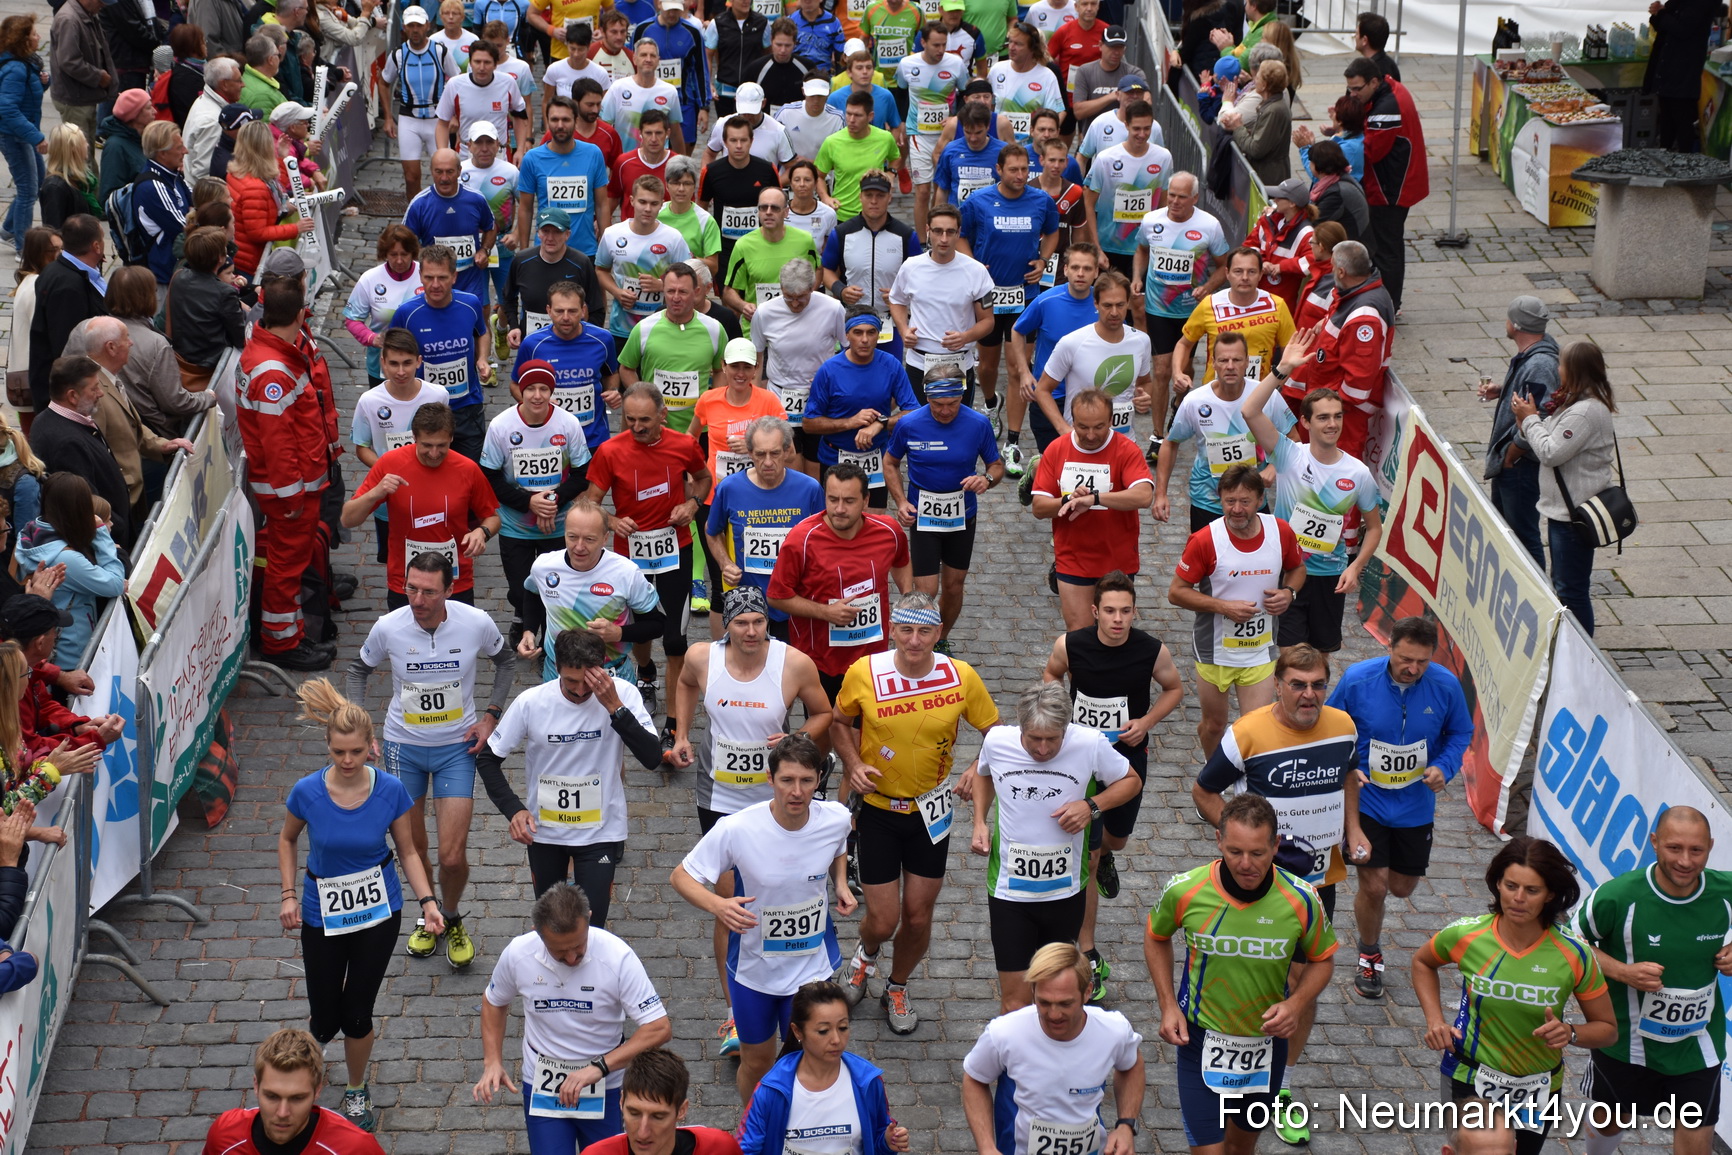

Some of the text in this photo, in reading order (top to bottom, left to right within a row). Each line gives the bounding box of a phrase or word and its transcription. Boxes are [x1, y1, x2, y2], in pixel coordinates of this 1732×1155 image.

[874, 26, 912, 36] BOCK
[880, 45, 905, 58] 2825
[657, 67, 675, 78] 194
[333, 101, 347, 120] BMW
[924, 112, 944, 123] 238
[310, 112, 320, 135] BMW
[958, 167, 992, 175] HUBER
[292, 176, 305, 199] BMW
[552, 186, 584, 199] 2276
[1567, 184, 1600, 203] Neumar
[317, 194, 333, 204] BMW
[1123, 198, 1145, 210] 126
[1551, 191, 1597, 219] Lammsb
[726, 214, 756, 227] 3046
[994, 217, 1031, 225] HUBER
[1158, 257, 1190, 272] 2048
[992, 291, 1023, 304] 2259
[1217, 316, 1279, 333] MAX BÖGL
[424, 338, 468, 352] SYSCAD
[429, 369, 464, 385] 2590
[555, 368, 594, 379] YSCAD
[663, 381, 690, 396] 257
[1222, 446, 1243, 462] 55
[519, 457, 559, 475] 2592
[528, 478, 552, 486] Manuel
[1075, 475, 1094, 490] 24
[749, 508, 801, 517] NEUMARKTER
[923, 502, 960, 517] 2641
[747, 516, 791, 524] STADTLAUF
[929, 519, 954, 527] Hartmut
[1304, 520, 1327, 538] 28
[634, 538, 674, 557] 2168
[750, 539, 780, 556] 251
[1299, 537, 1321, 549] Florian
[1449, 481, 1539, 661] Egner
[848, 631, 866, 640] Adolf
[1234, 619, 1265, 638] 259
[1239, 639, 1261, 647] Rainer
[403, 684, 450, 693] PARTL Neumarkt
[420, 693, 445, 710] 80
[730, 701, 768, 709] KLEBL
[877, 692, 964, 718] MAX BÖGL
[419, 714, 448, 723] Helmut
[1078, 706, 1121, 729] 2521
[717, 742, 735, 751] PARTL
[1371, 743, 1419, 755] PARTL Neumarkt
[726, 753, 764, 772] 239
[1380, 754, 1417, 772] 300
[1283, 765, 1341, 783] Fischer
[1390, 774, 1407, 783] Max
[540, 779, 560, 787] PARTL
[1289, 778, 1338, 789] AUTOMOBILE
[558, 790, 581, 809] 81
[926, 789, 952, 821] 273
[1312, 806, 1326, 814] und
[1329, 802, 1341, 811] viel
[558, 814, 581, 822] Klaus
[1307, 831, 1336, 841] Thomas
[1010, 847, 1062, 857] PARTL Neumarkt
[1014, 857, 1067, 879] 3043
[342, 875, 372, 887] Neumarkt
[326, 881, 382, 913] 2045
[787, 904, 817, 916] Neumarkt
[342, 911, 372, 925] Andrea
[769, 910, 821, 938] 2397
[785, 940, 809, 950] Peter
[1193, 932, 1290, 960] BOCK
[1471, 974, 1561, 1006] BOCK
[1675, 993, 1706, 1001] Neumarkt
[1649, 998, 1707, 1022] 2665
[1660, 1026, 1690, 1036] Stefan
[1206, 1034, 1263, 1049] PARTL Neumarkt
[538, 1057, 591, 1070] PARTL Neumar
[1210, 1047, 1267, 1070] 2792
[540, 1069, 596, 1094] 221
[1222, 1075, 1250, 1087] Gerald
[1480, 1068, 1539, 1088] PARTL Neumarkt
[1482, 1081, 1540, 1104] 2791
[1032, 1124, 1093, 1135] PARTL Neumarkt
[1036, 1129, 1096, 1155] 2557
